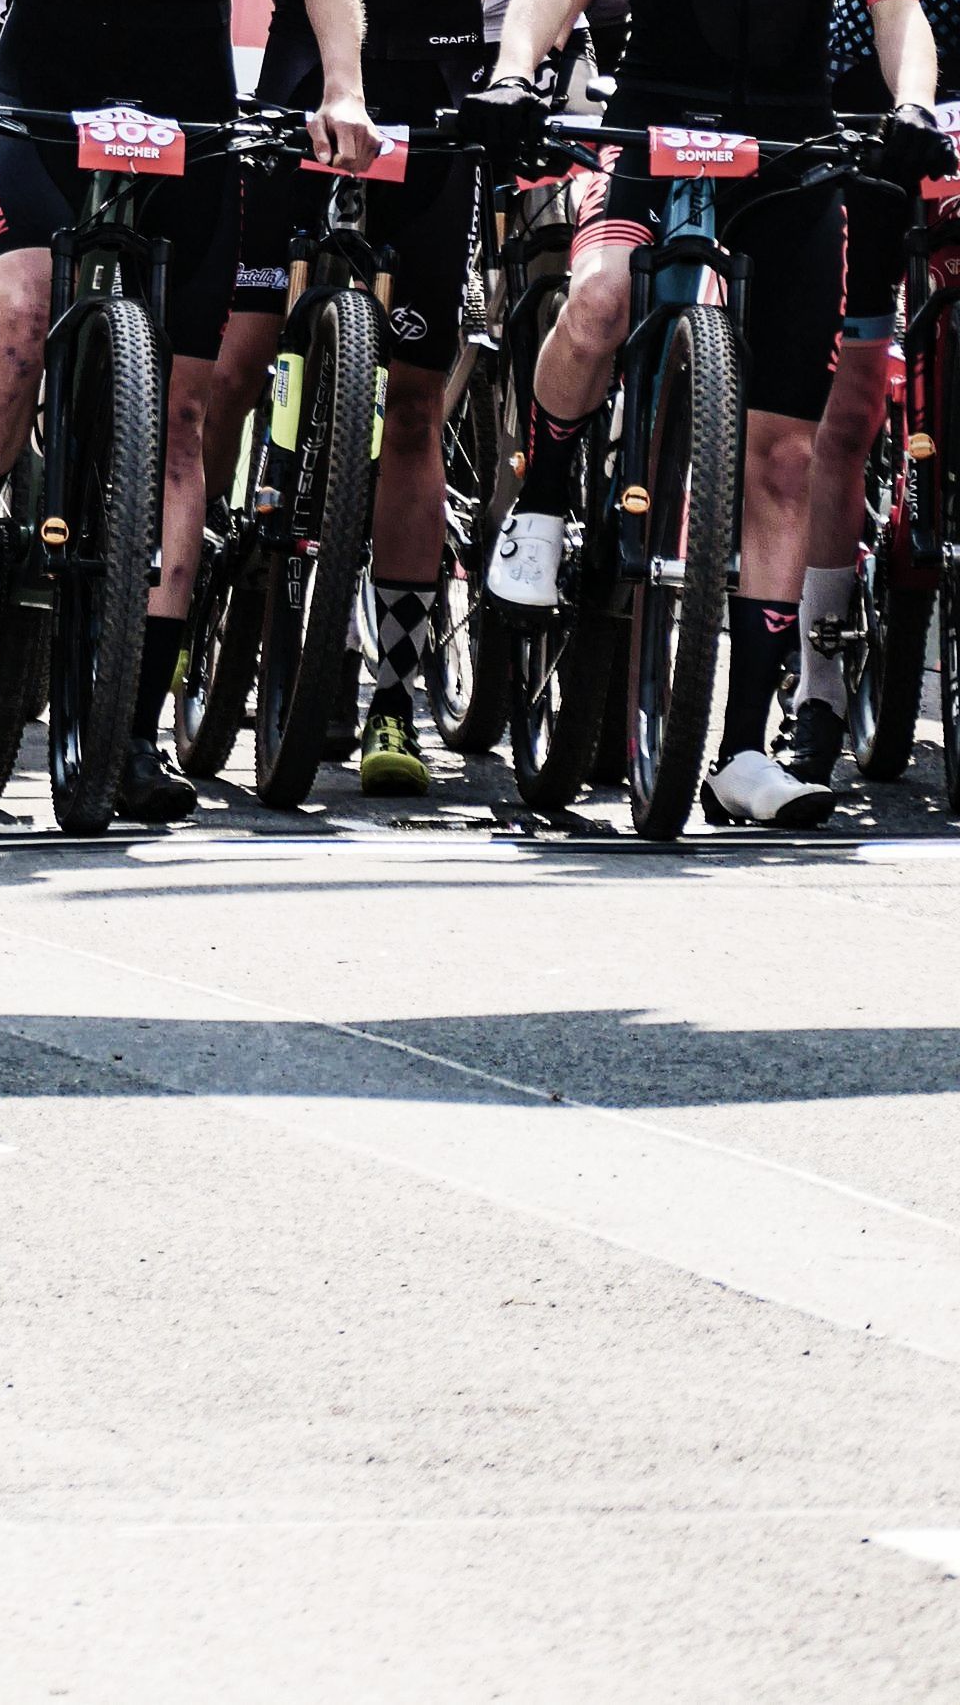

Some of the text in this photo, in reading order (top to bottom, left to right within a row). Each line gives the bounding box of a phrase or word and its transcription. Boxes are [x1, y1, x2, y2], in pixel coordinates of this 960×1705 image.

[428, 34, 472, 45] CRAFT
[660, 130, 748, 150] 307
[104, 143, 160, 159] FISCHER
[676, 150, 734, 163] SOMMER
